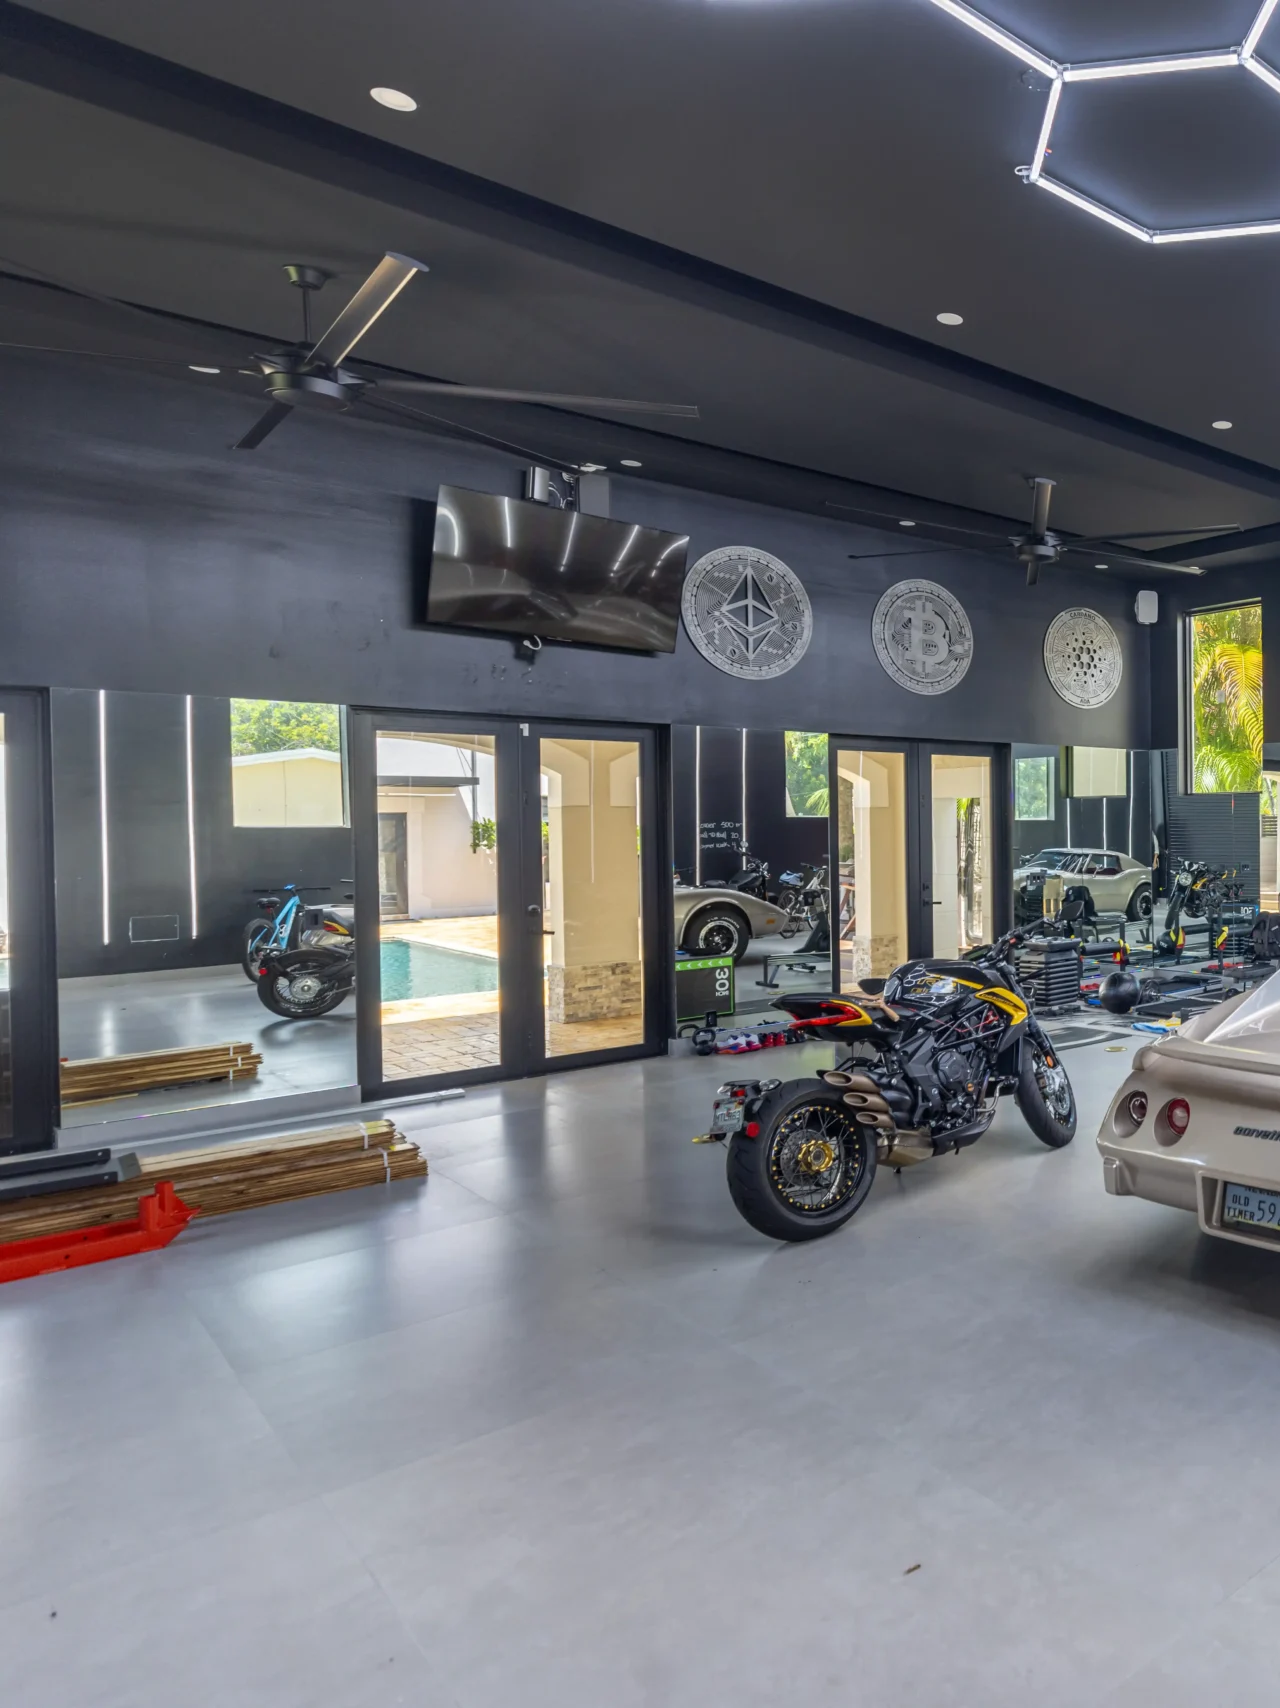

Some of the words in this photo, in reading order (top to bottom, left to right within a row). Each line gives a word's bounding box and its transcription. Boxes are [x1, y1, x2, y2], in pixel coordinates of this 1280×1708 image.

[1069, 611, 1096, 621] CARDANO
[720, 821, 734, 829] 500
[715, 967, 729, 991] 30
[1232, 1193, 1250, 1207] OLD
[1226, 1205, 1256, 1222] TIMER
